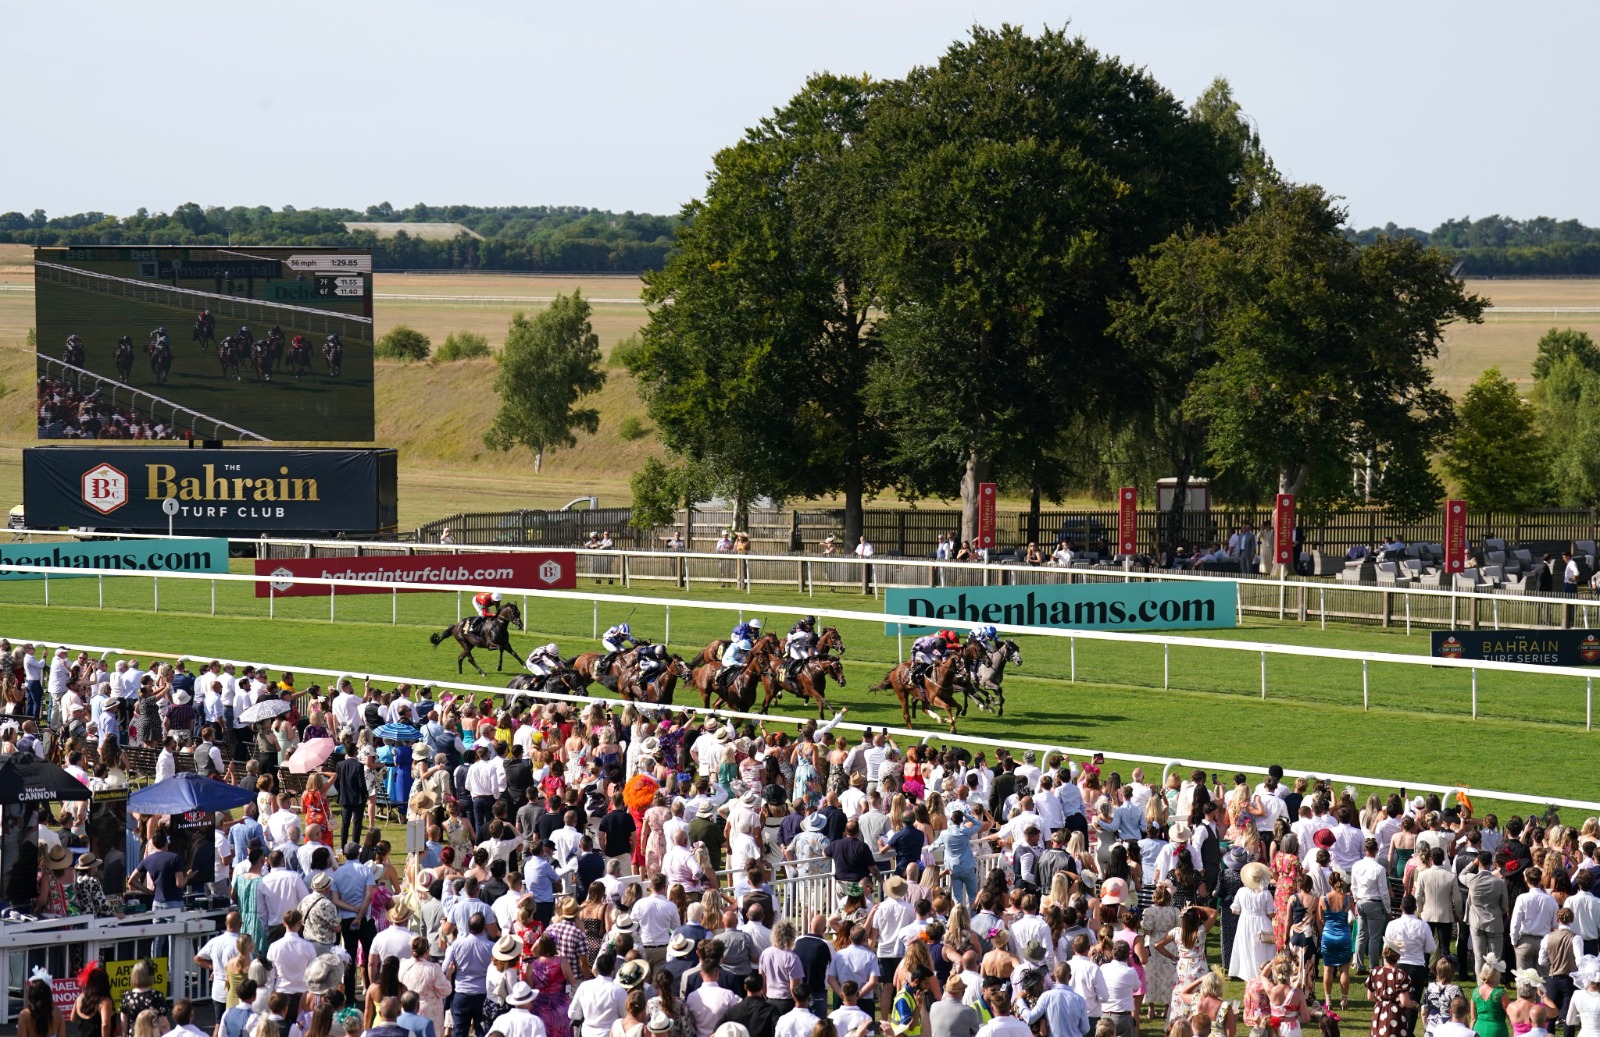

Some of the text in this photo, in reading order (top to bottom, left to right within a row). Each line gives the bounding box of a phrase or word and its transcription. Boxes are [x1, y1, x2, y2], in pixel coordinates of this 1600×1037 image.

[331, 259, 358, 267] 1:29.85
[161, 263, 246, 277] emondson
[319, 278, 328, 286] 7f
[145, 463, 321, 501] Bahrain
[168, 502, 173, 511] 1
[181, 506, 285, 518] TURF CLUB
[1450, 519, 1458, 554] Bahrain
[907, 591, 1215, 629] Debenhams.com
[1482, 641, 1559, 653] BAHRAIN
[1483, 654, 1558, 663] TURF SERIES
[19, 791, 57, 801] CANNON
[116, 963, 158, 976] ARR
[51, 981, 80, 992] HAEL
[110, 973, 163, 988] NICS
